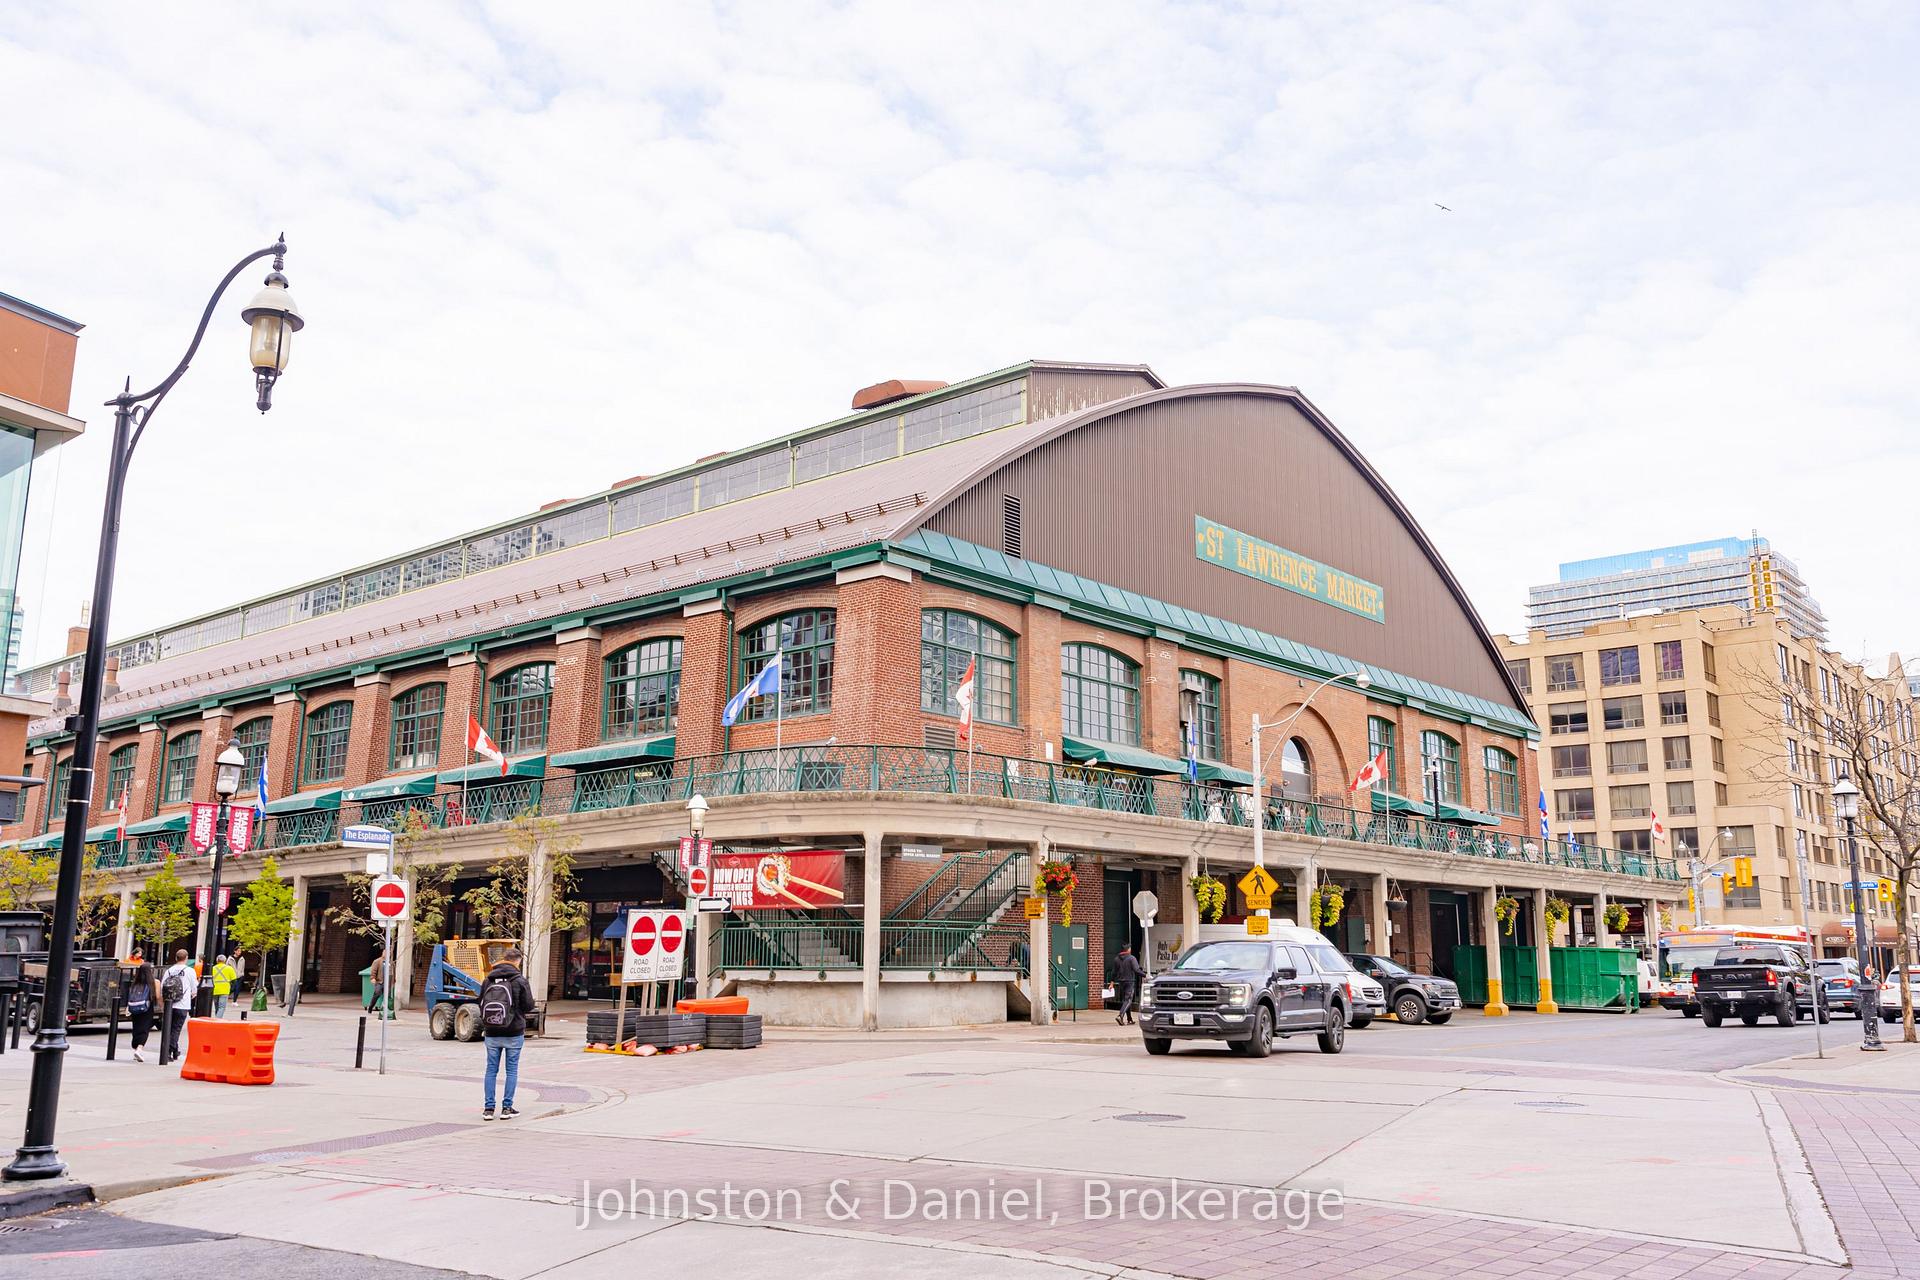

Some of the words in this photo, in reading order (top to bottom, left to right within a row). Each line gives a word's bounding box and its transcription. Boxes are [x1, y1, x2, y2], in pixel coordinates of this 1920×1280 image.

[1237, 537, 1317, 594] LAWRENCE
[1327, 571, 1379, 616] MARKET
[194, 807, 205, 842] STREET
[201, 808, 213, 848] MARKET
[231, 810, 242, 845] STREET
[238, 811, 250, 851] MARKET
[345, 830, 357, 839] The
[358, 831, 390, 841] Esplanade
[714, 868, 733, 884] NOW
[733, 868, 754, 883] OPEN
[1157, 951, 1170, 960] Pasta
